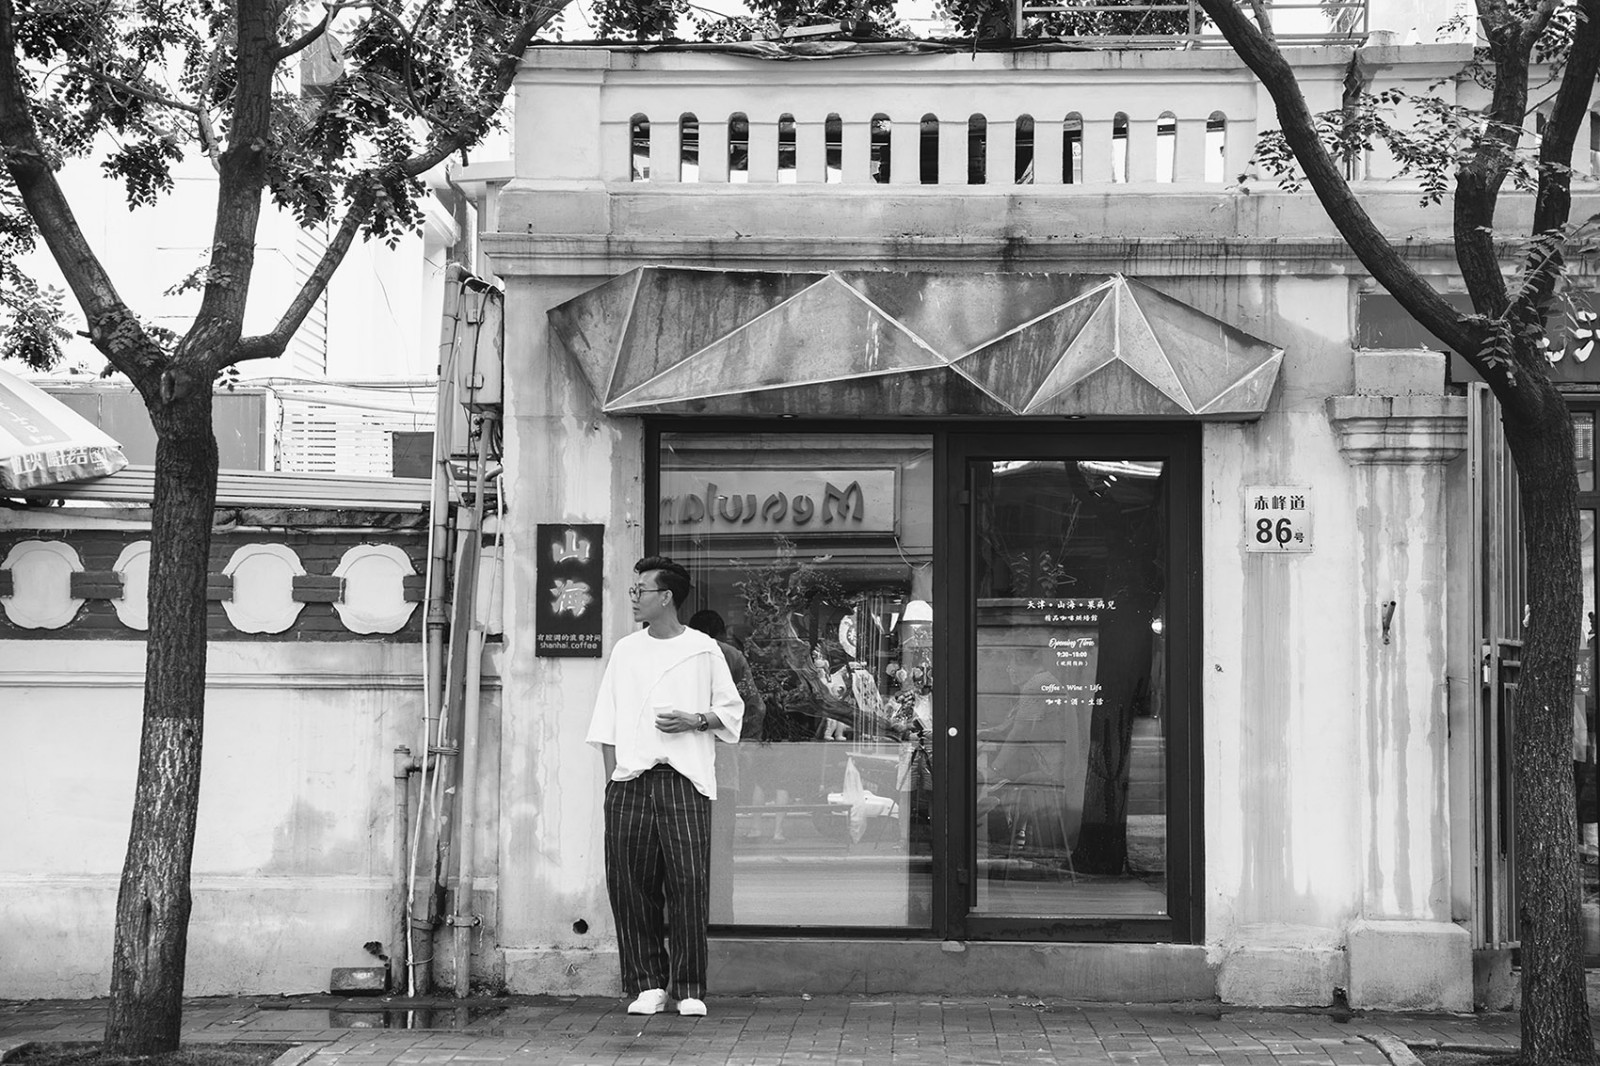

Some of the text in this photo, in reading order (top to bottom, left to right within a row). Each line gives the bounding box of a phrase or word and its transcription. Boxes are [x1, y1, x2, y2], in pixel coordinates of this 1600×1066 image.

[1254, 495, 1305, 510] 赤峰道
[1041, 684, 1060, 693] Coffee
[1089, 684, 1102, 693] Life
